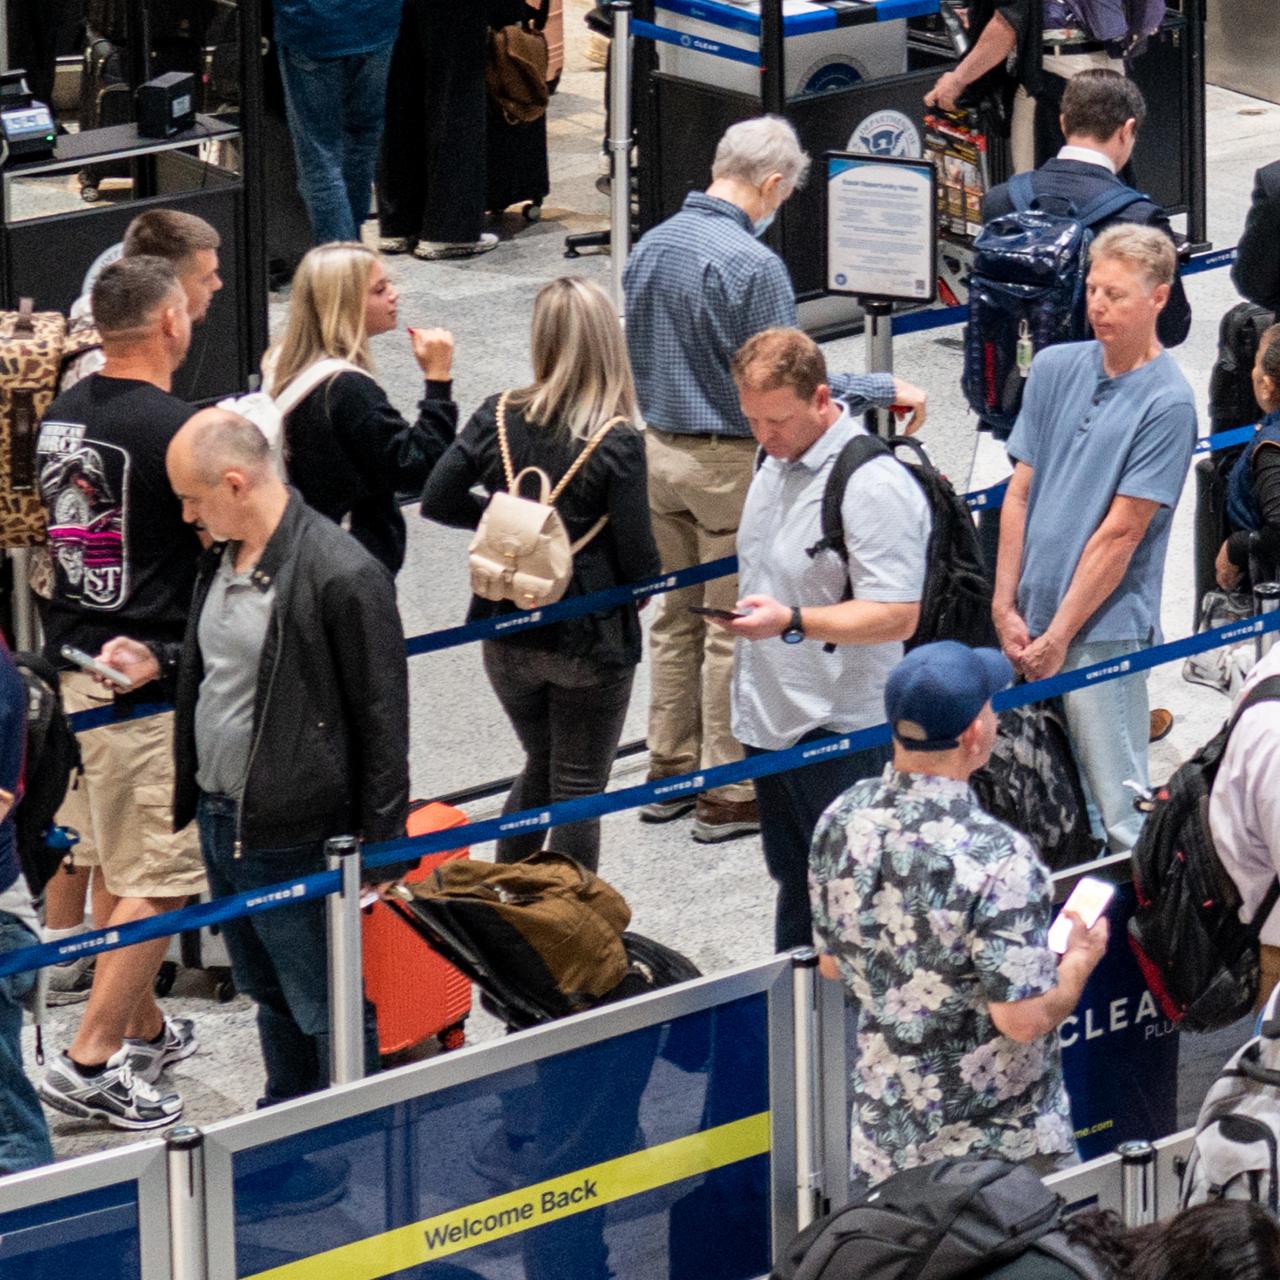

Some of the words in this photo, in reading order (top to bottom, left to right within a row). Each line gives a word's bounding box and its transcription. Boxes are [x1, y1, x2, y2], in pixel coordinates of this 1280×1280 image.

[694, 40, 719, 51] CLEAR
[632, 581, 666, 596] UNITED
[495, 614, 530, 630] UNITED
[1221, 625, 1253, 640] UNITED
[1086, 665, 1120, 680] UNITED
[803, 742, 840, 758] UNITED
[654, 780, 692, 795] UNITED
[500, 816, 540, 832] UNITED
[246, 890, 291, 908] UNITED
[58, 935, 104, 954] UNITED
[1056, 990, 1158, 1048] CLEA
[1145, 1018, 1175, 1040] PLU
[1073, 1119, 1113, 1139] me.com
[424, 1202, 533, 1251] Welcome
[540, 1179, 598, 1215] Back
